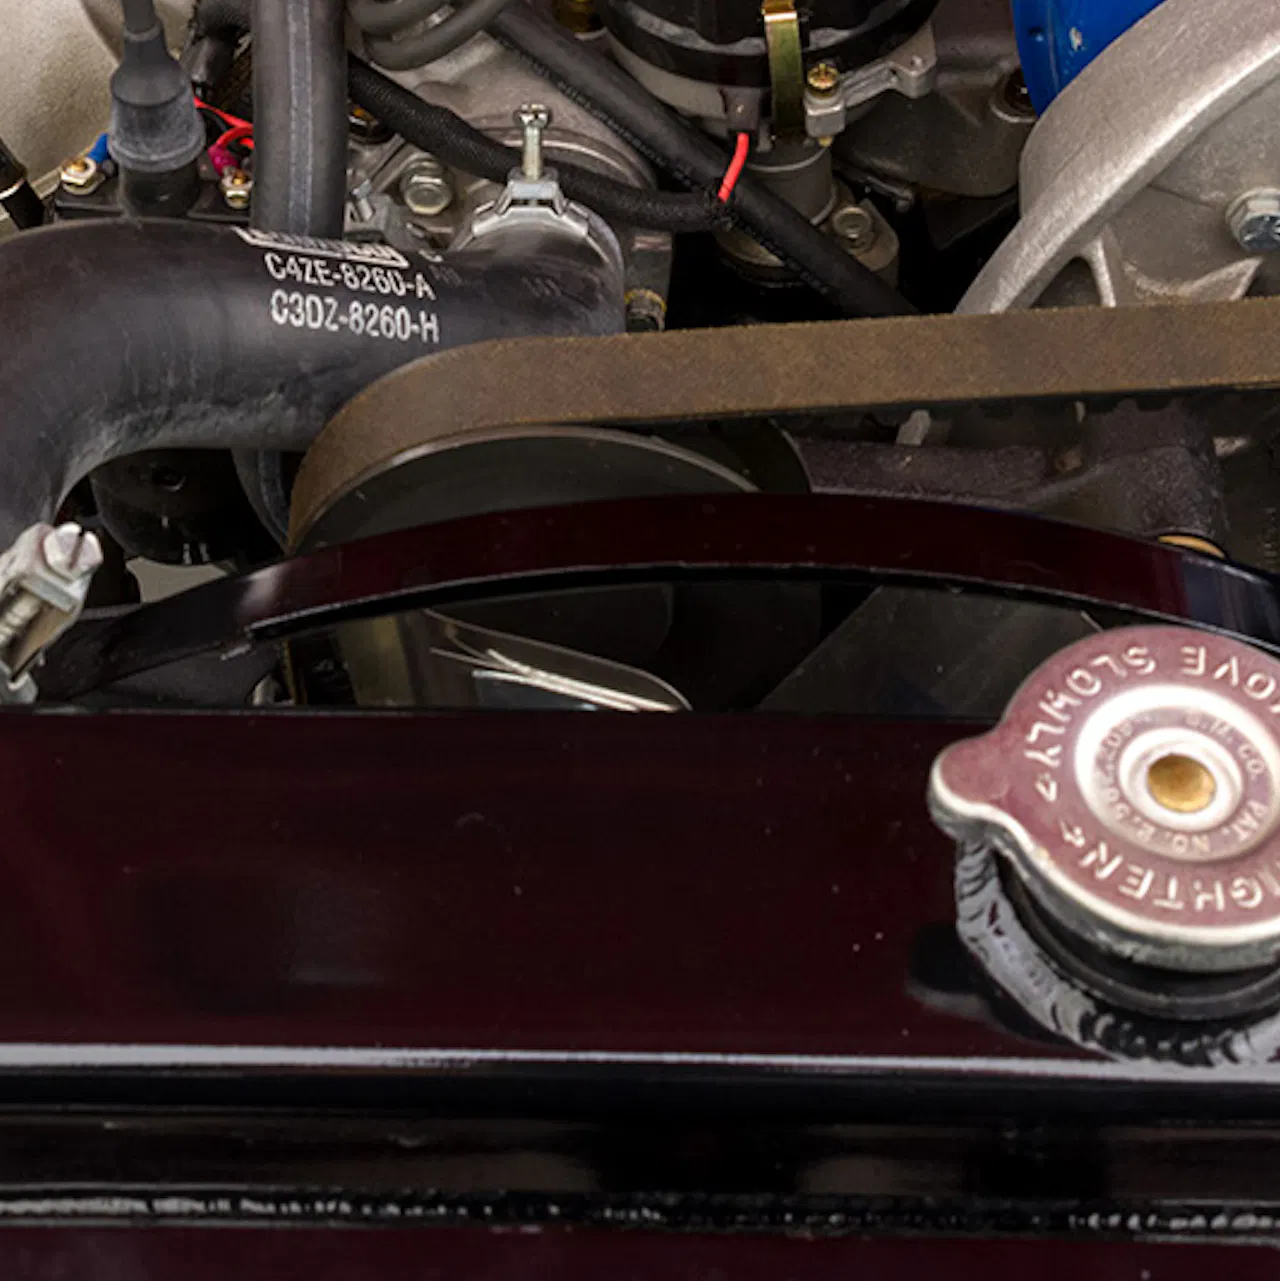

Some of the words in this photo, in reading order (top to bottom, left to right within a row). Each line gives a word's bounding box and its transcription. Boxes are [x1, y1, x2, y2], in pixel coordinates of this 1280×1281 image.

[264, 252, 436, 301] C4ZE-8260-A
[271, 288, 440, 343] C3DZ-8260-H
[1023, 646, 1157, 772] SLOWLY
